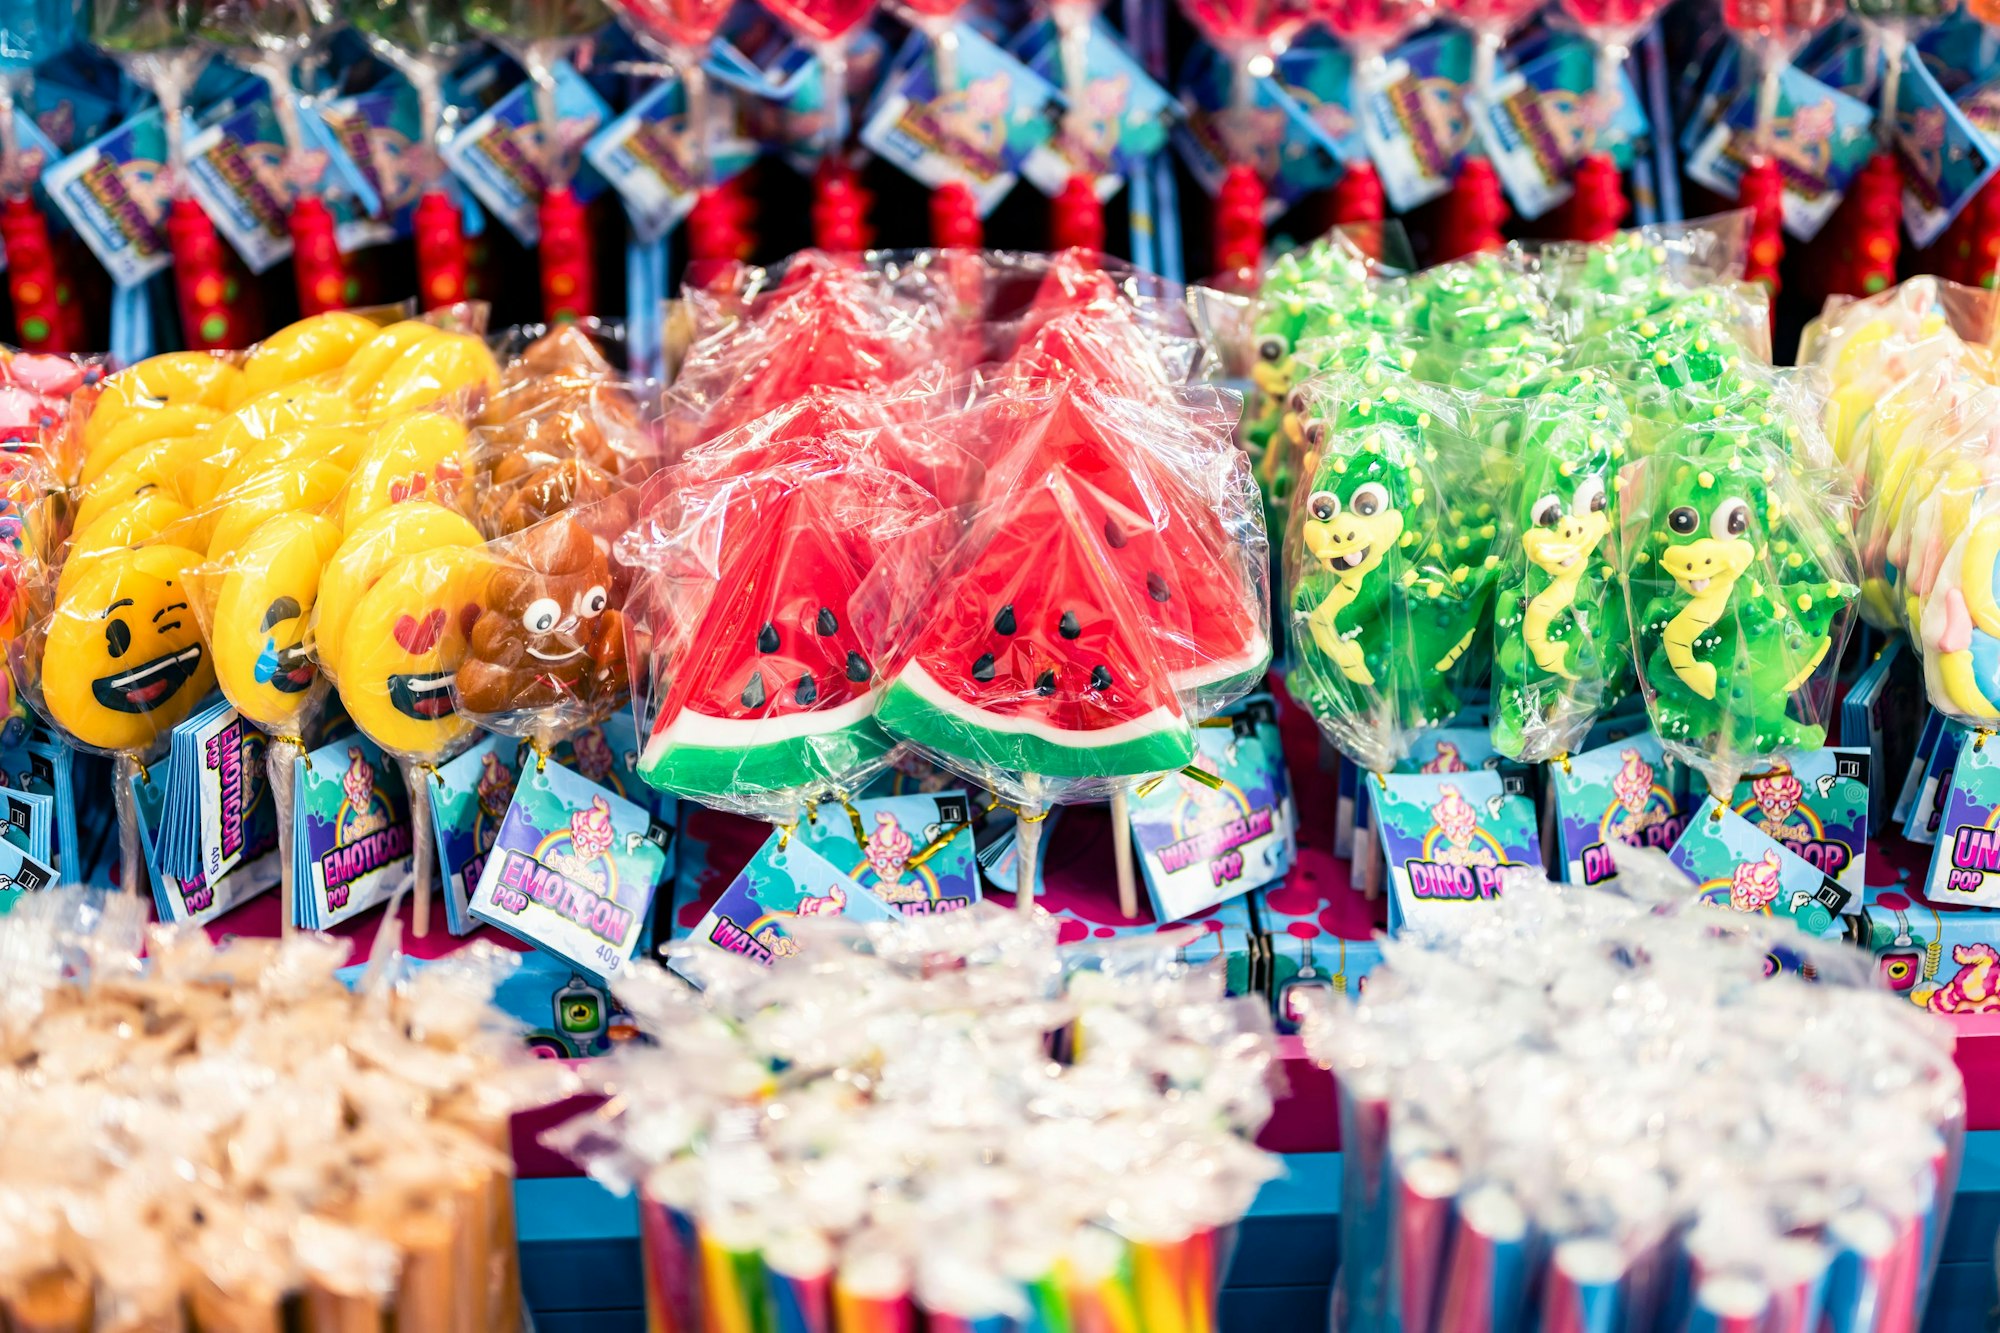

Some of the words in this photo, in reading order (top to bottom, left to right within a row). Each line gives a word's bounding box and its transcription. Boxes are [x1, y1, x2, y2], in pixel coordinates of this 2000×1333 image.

[206, 734, 220, 770] POP
[220, 718, 243, 860] EMOTICON
[1157, 807, 1273, 875] WATERMELON
[210, 846, 220, 876] 40g
[1211, 851, 1243, 886] POP
[1408, 861, 1476, 898] DINO
[1948, 869, 1982, 892] POP
[185, 886, 213, 916] POP
[327, 883, 350, 912] POP
[493, 885, 528, 914] POP
[502, 854, 631, 943] EMOTICON
[594, 943, 621, 971] 40g
